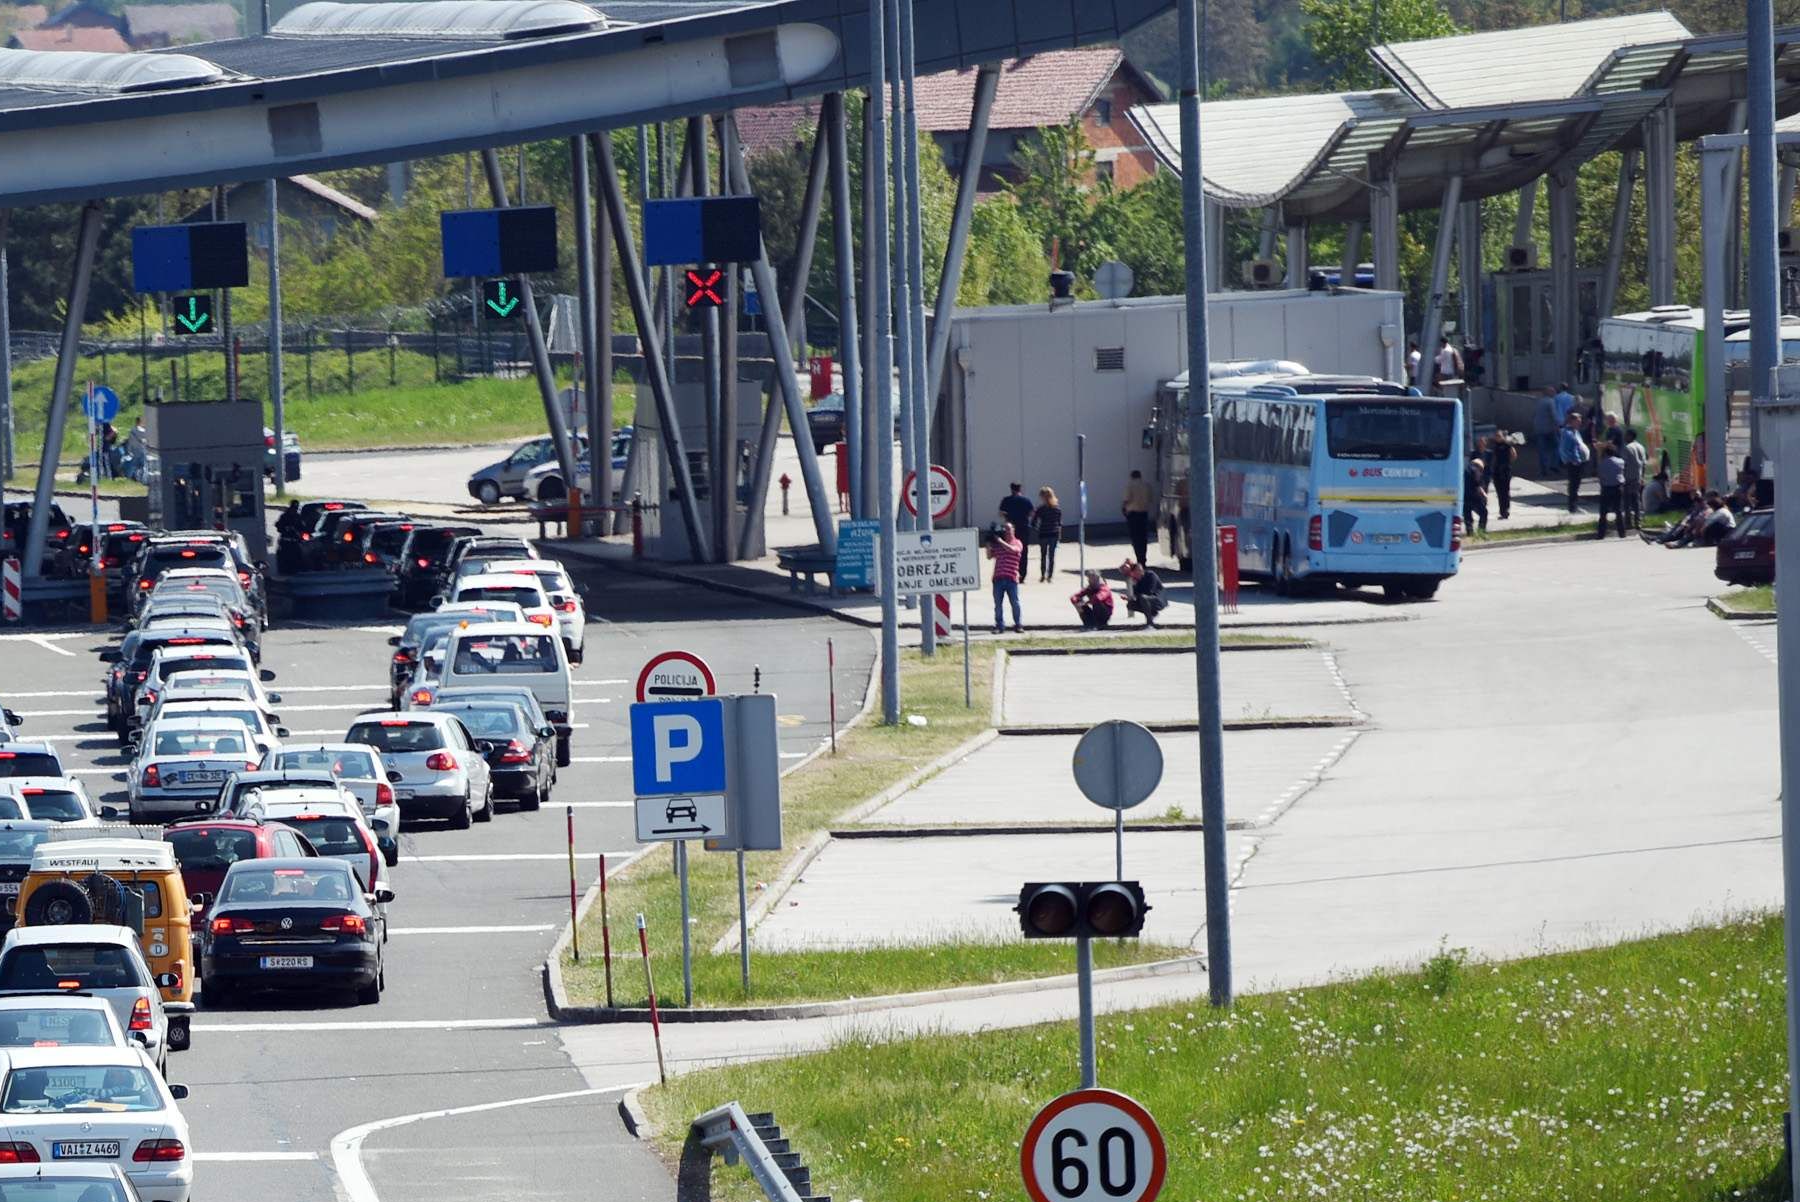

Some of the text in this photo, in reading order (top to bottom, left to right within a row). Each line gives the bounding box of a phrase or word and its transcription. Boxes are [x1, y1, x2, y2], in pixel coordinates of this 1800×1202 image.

[897, 561, 957, 577] OBREŽJE
[897, 576, 975, 589] ANJE OMEJENO
[654, 674, 698, 686] POLICIJA
[653, 714, 703, 782] P
[50, 859, 99, 867] WESTFALIA
[155, 944, 163, 955] D
[61, 1143, 119, 1155] VAI Z 4469
[1052, 1127, 1146, 1199] 60
